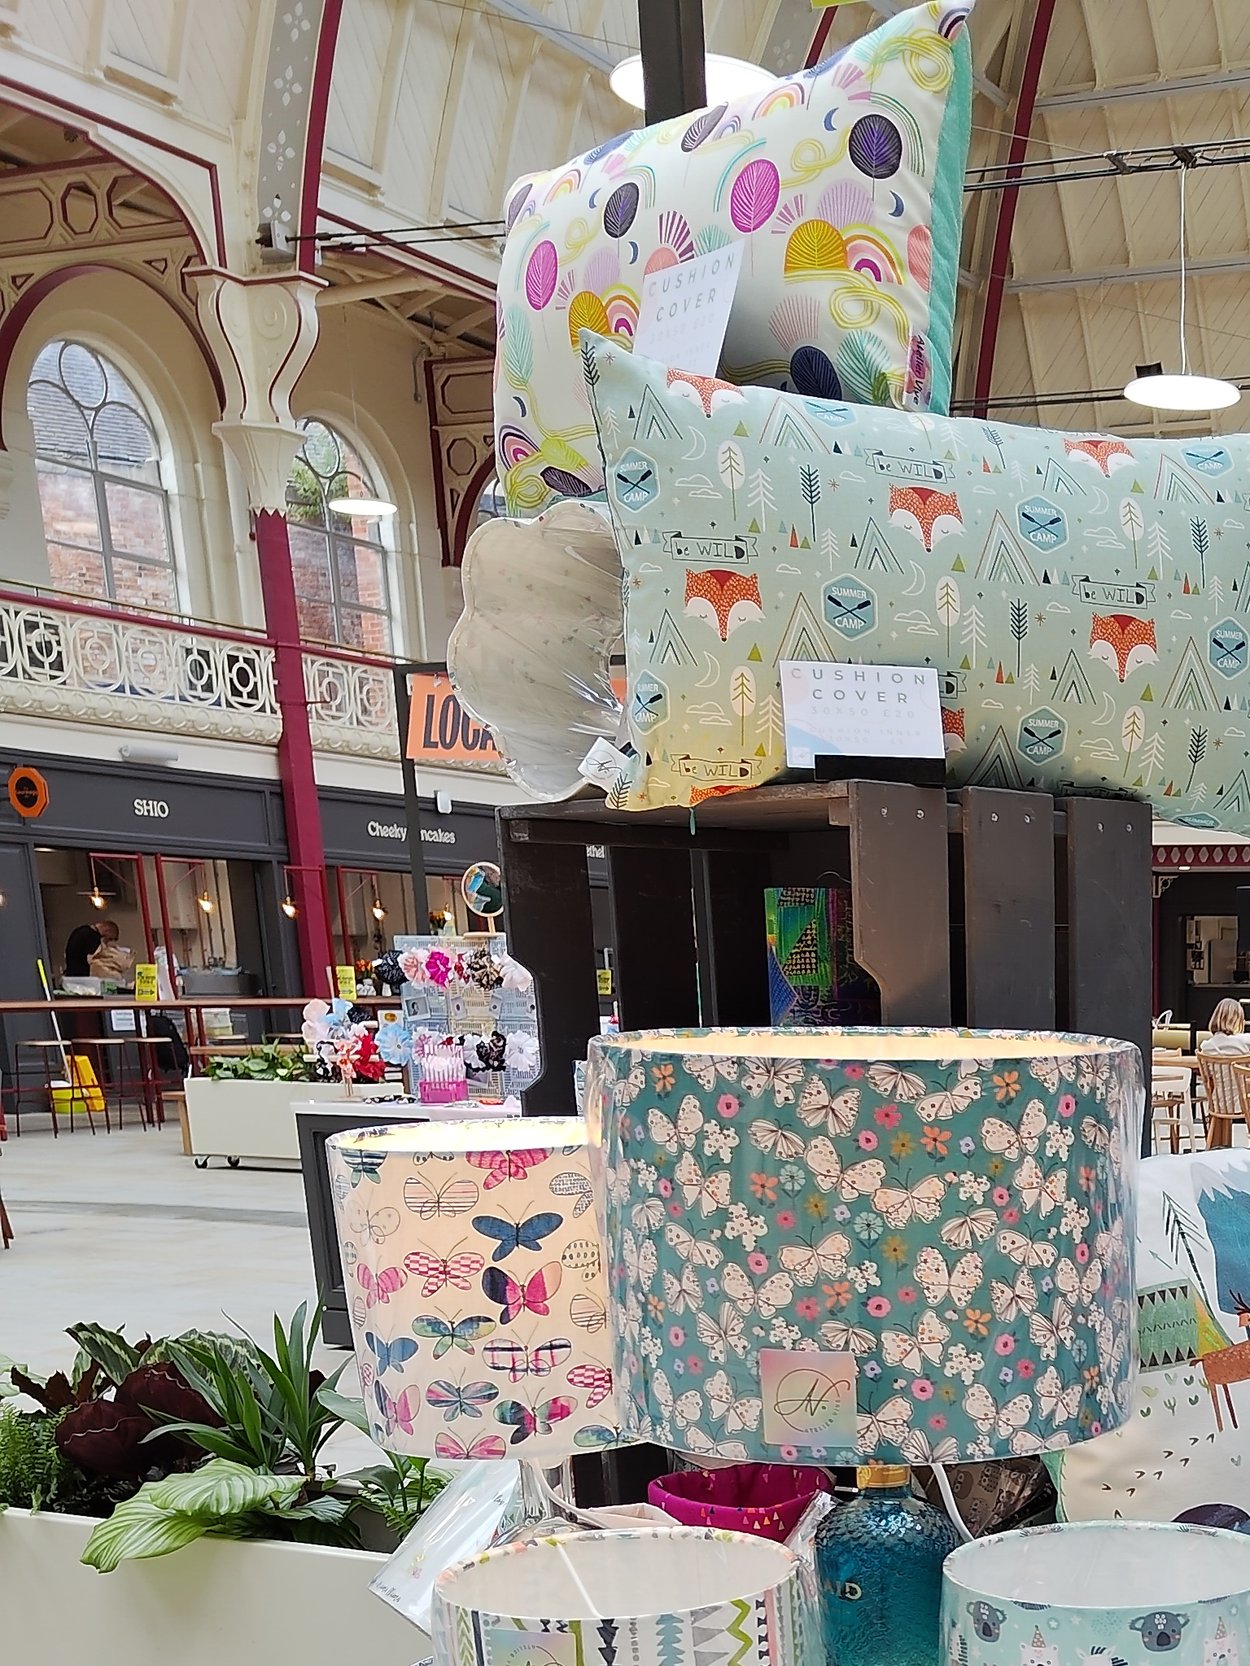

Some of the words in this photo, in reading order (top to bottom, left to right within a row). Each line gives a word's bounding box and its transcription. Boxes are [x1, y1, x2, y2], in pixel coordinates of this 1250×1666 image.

[648, 252, 736, 297] CUSHION
[656, 287, 717, 323] COVER
[914, 334, 926, 375] Atelier
[912, 380, 924, 405] Vive
[899, 462, 944, 480] WILD
[1023, 503, 1058, 517] SUMMER
[1029, 532, 1058, 544] CAMP
[675, 543, 691, 557] be
[698, 544, 747, 560] WILD
[830, 584, 868, 600] SUMMER
[1082, 589, 1096, 601] be
[1102, 589, 1146, 606] WILD
[834, 616, 865, 630] CAMP
[1215, 628, 1245, 641] SUMMER
[1216, 657, 1241, 670] CAMP
[791, 667, 927, 686] CUSHION
[811, 688, 908, 704] COVER
[1027, 718, 1060, 729] SUMMER
[1026, 746, 1054, 756] CAMP
[684, 764, 698, 774] be
[703, 763, 750, 779] WILD
[134, 797, 170, 818] SHIO
[367, 820, 407, 843] Cheeky
[420, 827, 456, 844] ncakes
